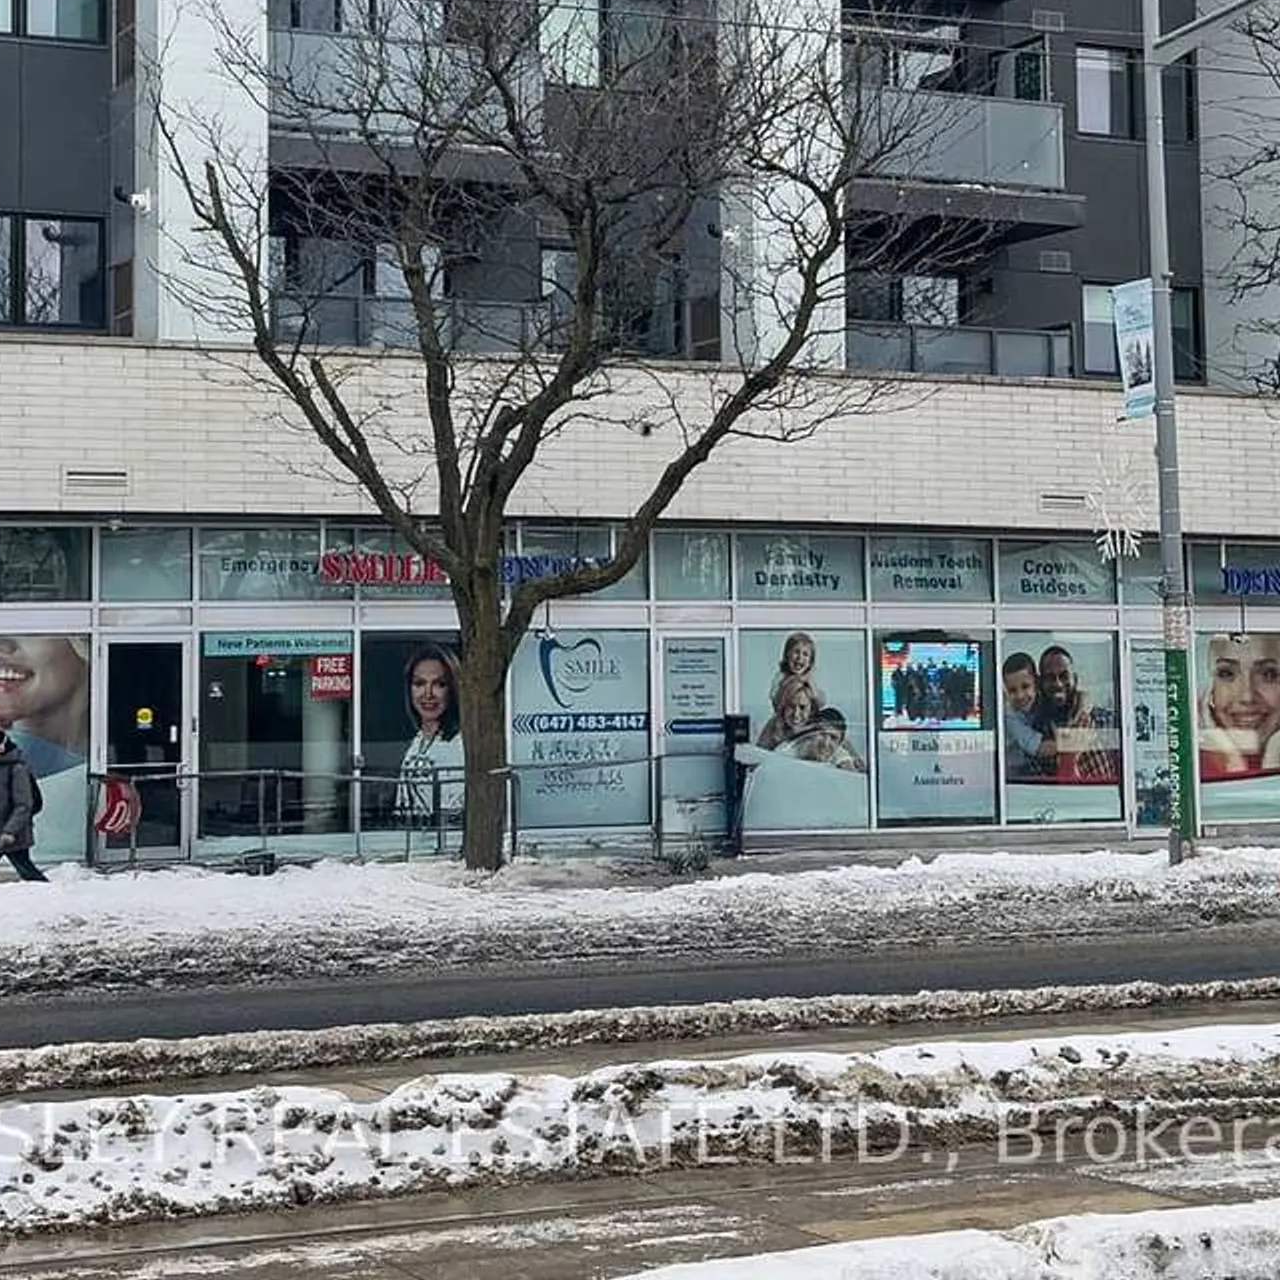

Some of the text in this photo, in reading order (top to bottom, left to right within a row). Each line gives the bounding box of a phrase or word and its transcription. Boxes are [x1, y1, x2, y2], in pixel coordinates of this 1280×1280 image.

[222, 558, 320, 575] Emergency
[870, 554, 982, 569] Wisdom Teeth
[1023, 559, 1078, 575] Crown
[754, 570, 841, 591] Dentistry
[893, 574, 962, 589] Removal
[1021, 578, 1087, 597] Bridges
[316, 656, 347, 673] FREE
[311, 675, 351, 692] PARKING
[534, 713, 645, 730] (647) 483-4147
